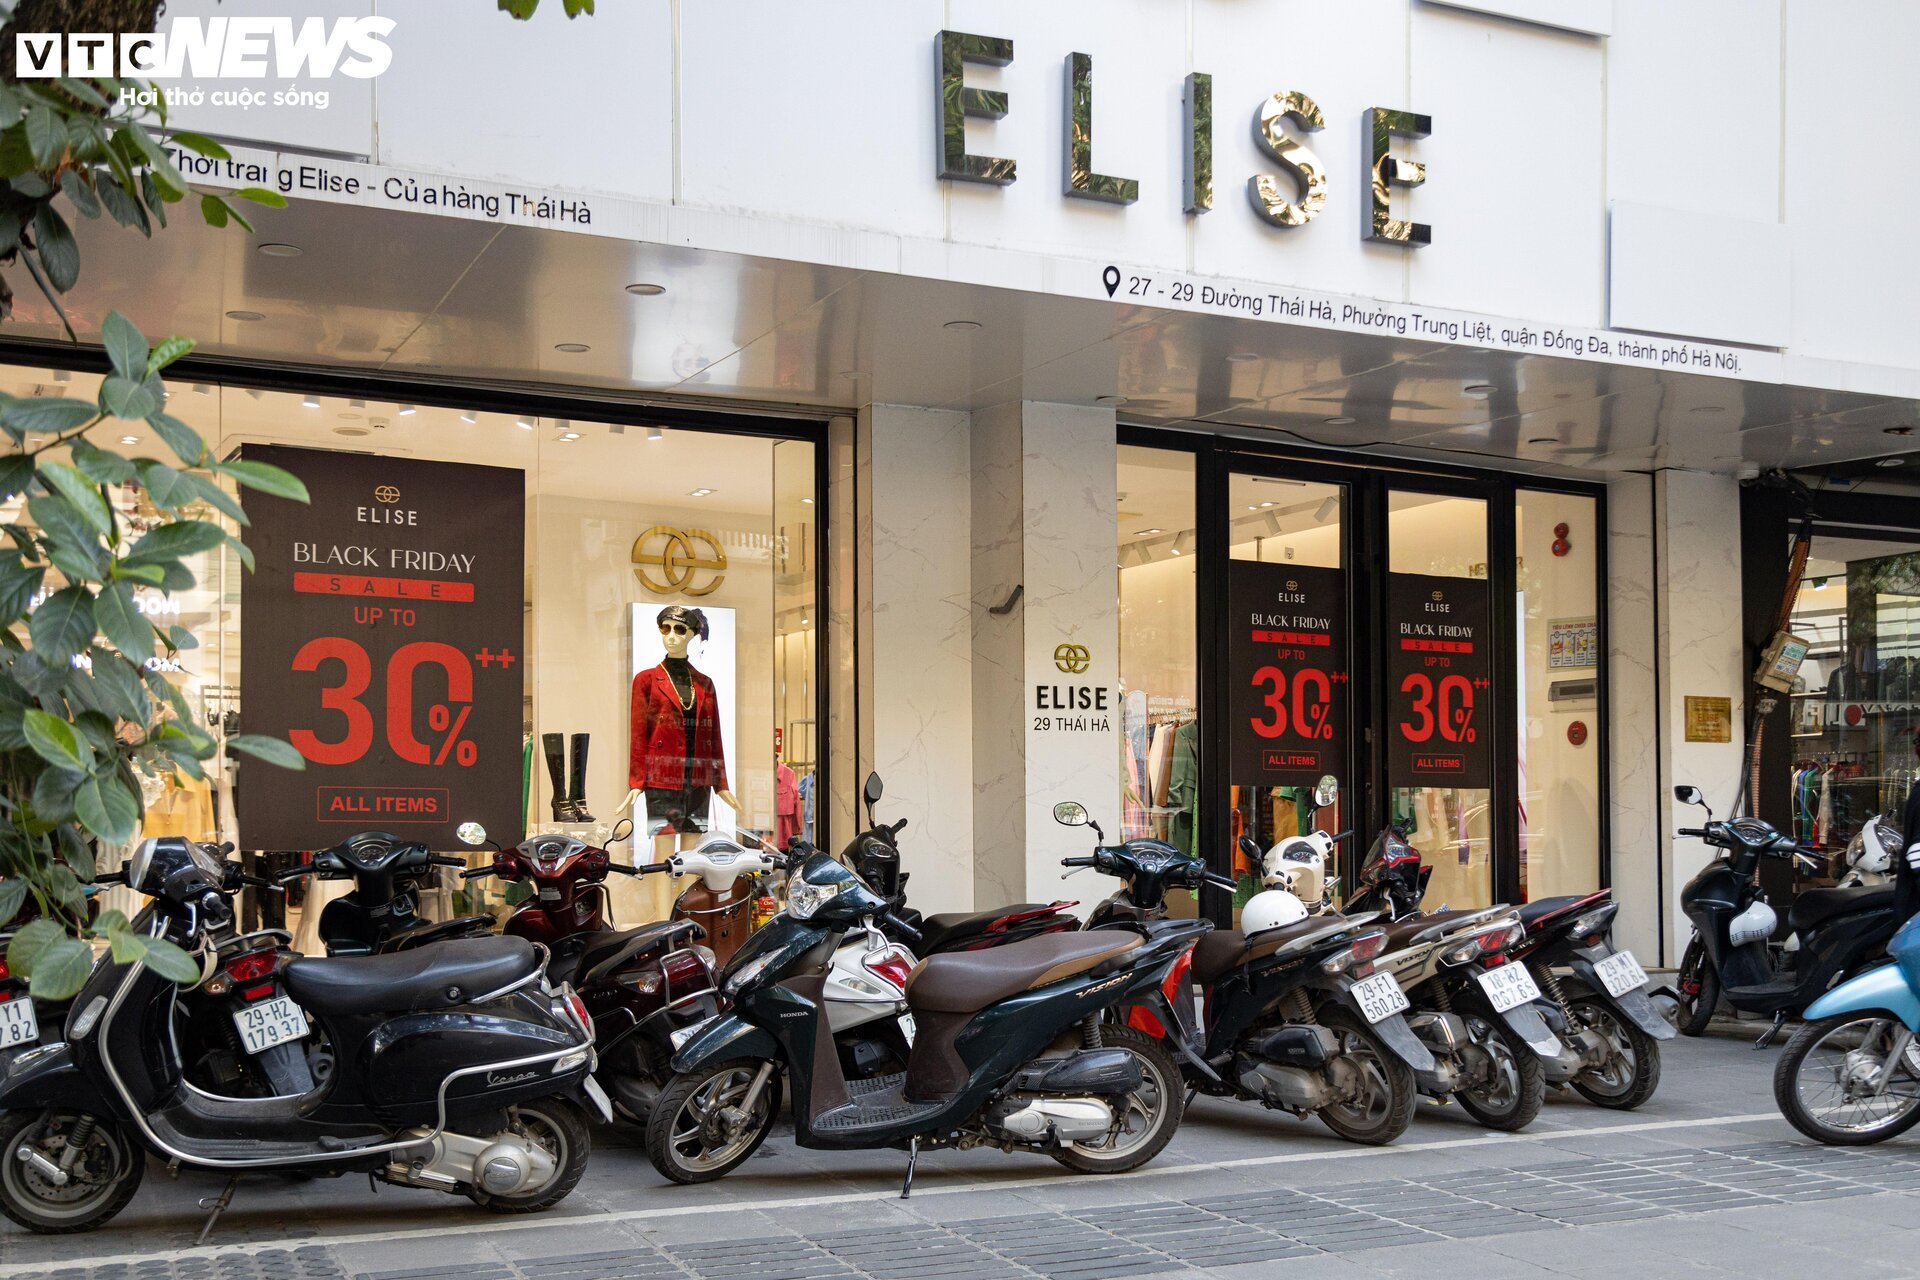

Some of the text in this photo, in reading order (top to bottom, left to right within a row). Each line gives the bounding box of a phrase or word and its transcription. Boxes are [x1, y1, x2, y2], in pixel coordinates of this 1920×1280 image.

[934, 30, 1432, 249] ELISE
[299, 166, 360, 194] Elise
[442, 185, 499, 217] hàng
[560, 199, 591, 224] Hà
[1128, 276, 1152, 297] 27
[1171, 282, 1194, 302] 29
[1201, 286, 1262, 316] Đường
[1269, 295, 1304, 317] Thái
[1309, 302, 1337, 324] Hà,
[1342, 303, 1407, 334] Phường
[1411, 314, 1458, 341] Trung
[1501, 327, 1538, 348] quận
[1543, 329, 1583, 356] Đống
[1588, 336, 1612, 357] Đa,
[1618, 341, 1658, 360] thành
[1661, 344, 1688, 366] phố
[1692, 349, 1711, 367] Hà
[357, 506, 418, 526] ELISE
[293, 541, 476, 573] BLACK FRIDAY
[329, 577, 441, 598] SALE
[1278, 592, 1305, 604] ELISE
[353, 606, 416, 626] UP TO
[1425, 602, 1450, 613] ELISE
[1251, 613, 1331, 630] BLACK FRIDAY
[1400, 622, 1474, 638] BLACK FRIDAY
[1267, 633, 1316, 644] SALE
[1415, 640, 1461, 652] SALE
[1277, 649, 1305, 661] UP TO
[1424, 656, 1450, 668] UP TO
[1036, 685, 1108, 711] ELISE
[1034, 715, 1110, 732] 29 THÁI HÀ
[1268, 755, 1316, 766] ALL ITEMS
[1416, 759, 1460, 769] ALL ITEMS
[330, 796, 438, 813] ALL ITEMS
[1358, 975, 1392, 1001] 29-F1
[1364, 991, 1405, 1020] 560.28
[244, 1000, 292, 1029] 29-H2
[247, 1017, 301, 1049] 179.37
[486, 1071, 539, 1088] Vespa
